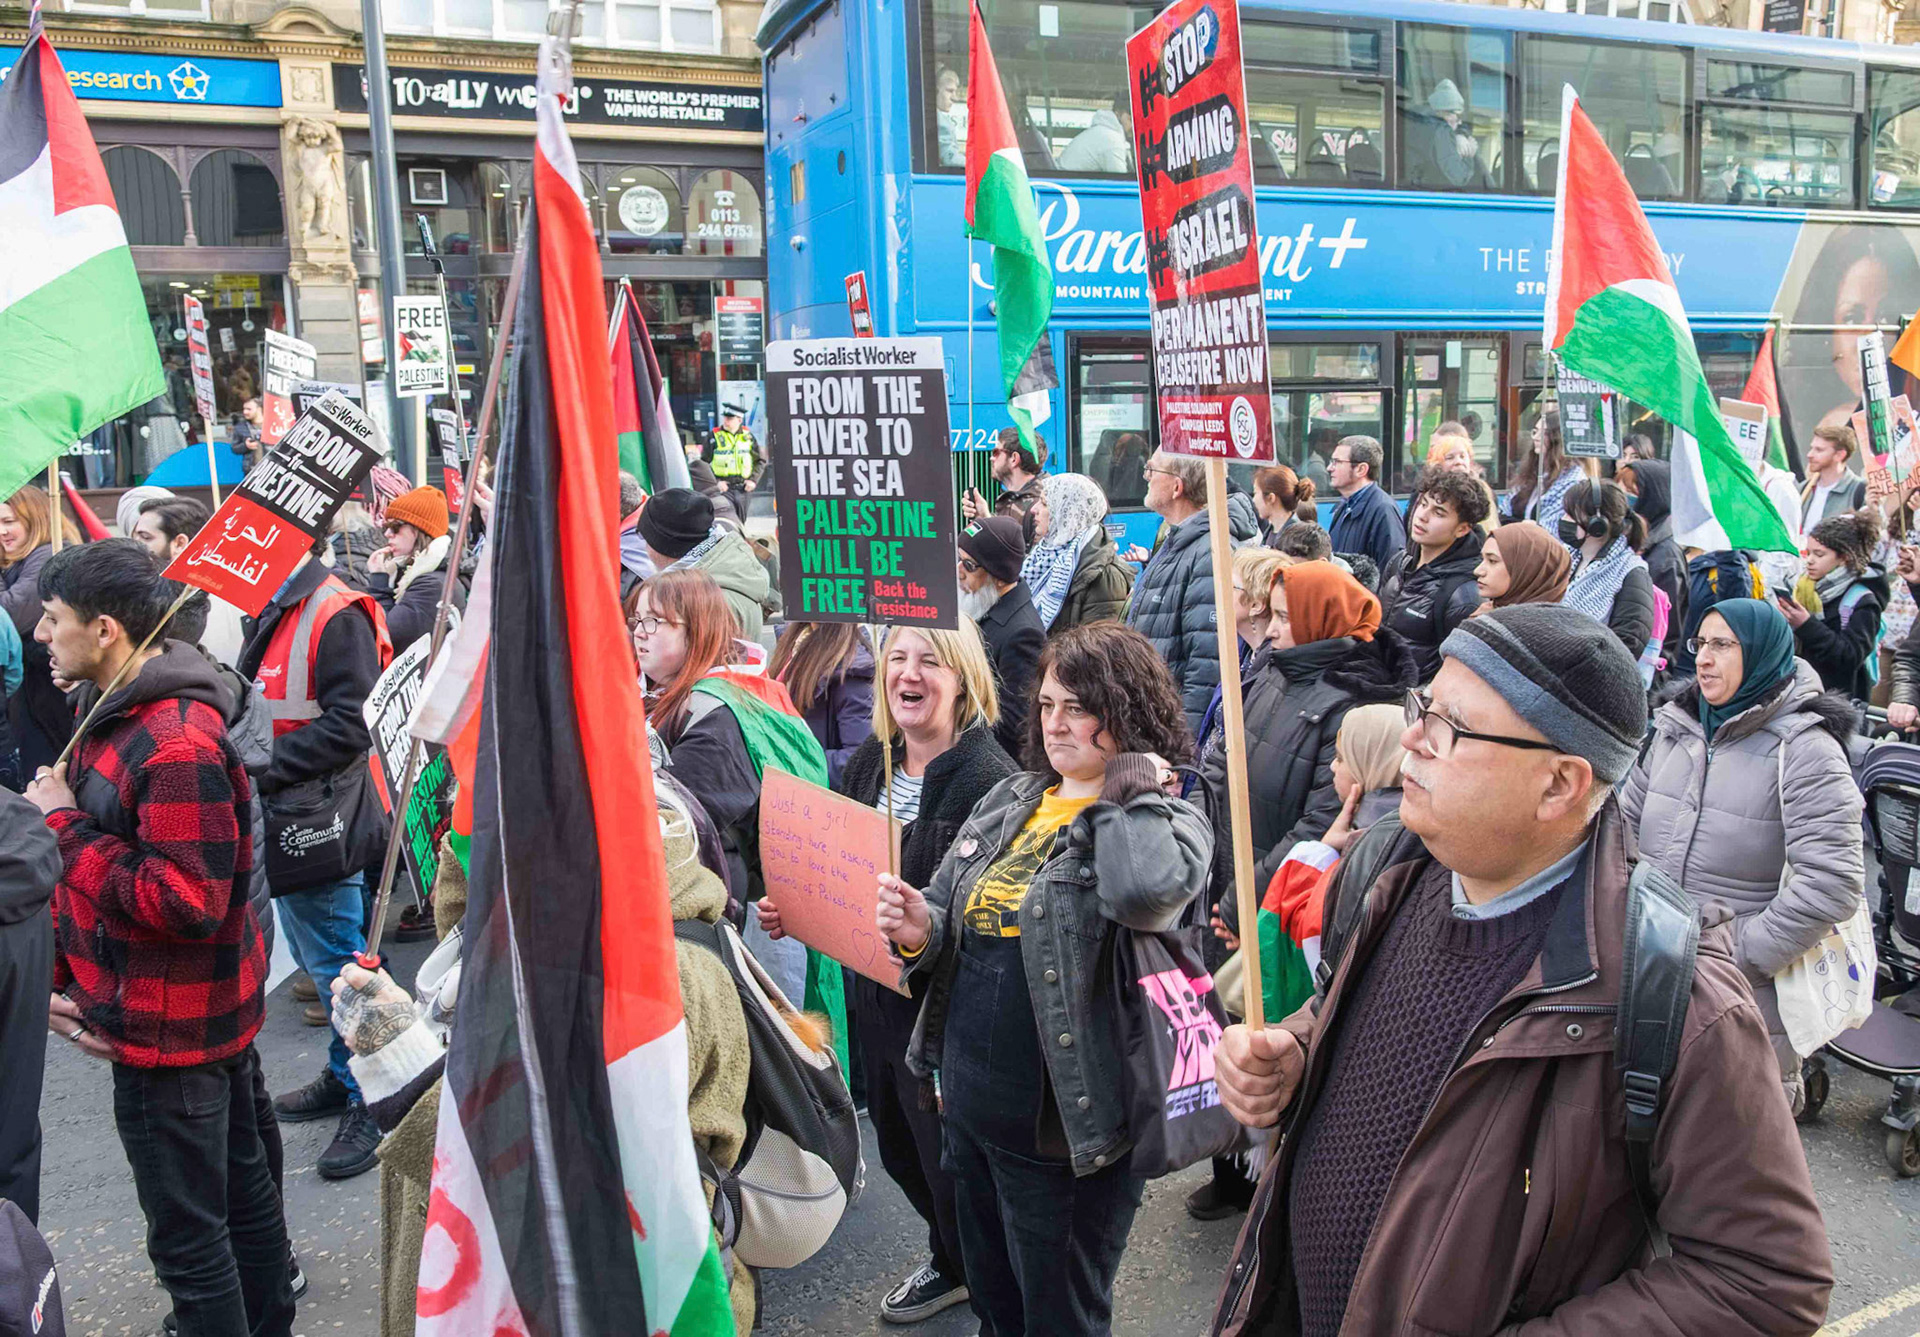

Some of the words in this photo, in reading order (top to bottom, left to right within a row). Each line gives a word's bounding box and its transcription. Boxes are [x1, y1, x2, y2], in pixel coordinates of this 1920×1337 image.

[1163, 12, 1211, 93] STOP
[67, 70, 163, 91] esearch
[604, 88, 635, 103] THE
[635, 90, 700, 106] WORLD'S
[701, 93, 760, 109] PREMIER
[604, 103, 660, 118] VAPING
[660, 106, 725, 121] RETAILER
[1167, 105, 1235, 172] ARMING
[698, 223, 722, 238] 244
[724, 224, 753, 239] 8753
[711, 209, 740, 223] 0113
[1172, 196, 1248, 272] ISRAEL
[1479, 248, 1531, 273] THE
[1055, 286, 1140, 299] MOUNTAIN
[398, 307, 443, 328] FREE
[1153, 293, 1261, 351] PERMANENT
[399, 367, 444, 384] PALESTINE
[1157, 350, 1222, 389] CEASEFIRE
[1225, 346, 1264, 384] NOW
[787, 376, 865, 415] FROM
[872, 375, 925, 414] THE
[1166, 402, 1191, 414] PALESTINE
[1191, 402, 1223, 415] SOLIDARITY
[790, 418, 869, 456] RIVER
[876, 417, 913, 456] TO
[1180, 419, 1204, 431] CAMPAIGN
[1205, 420, 1225, 433] LEEDS
[242, 457, 335, 528] PALESTINE
[792, 459, 846, 495] THE
[852, 458, 905, 497] SEA
[222, 506, 281, 550] الحرية
[796, 499, 937, 539] PALESTINE
[186, 539, 269, 586] لفلسطين
[798, 538, 864, 575] WILL
[869, 540, 906, 577] BE
[802, 577, 867, 614] FREE
[874, 580, 905, 597] Back
[907, 582, 927, 599] the
[875, 601, 938, 619] resistance
[378, 693, 403, 753] FROM
[400, 667, 424, 720] THE
[770, 788, 796, 814] Just
[802, 805, 813, 820] a
[821, 811, 849, 831] girl
[288, 820, 345, 847] Community
[295, 826, 315, 838] unite
[299, 832, 341, 850] membership
[769, 845, 785, 861] you
[808, 859, 826, 875] love
[830, 865, 849, 883] the
[840, 850, 875, 874] asking
[803, 883, 814, 894] of
[818, 883, 865, 917] Palestine
